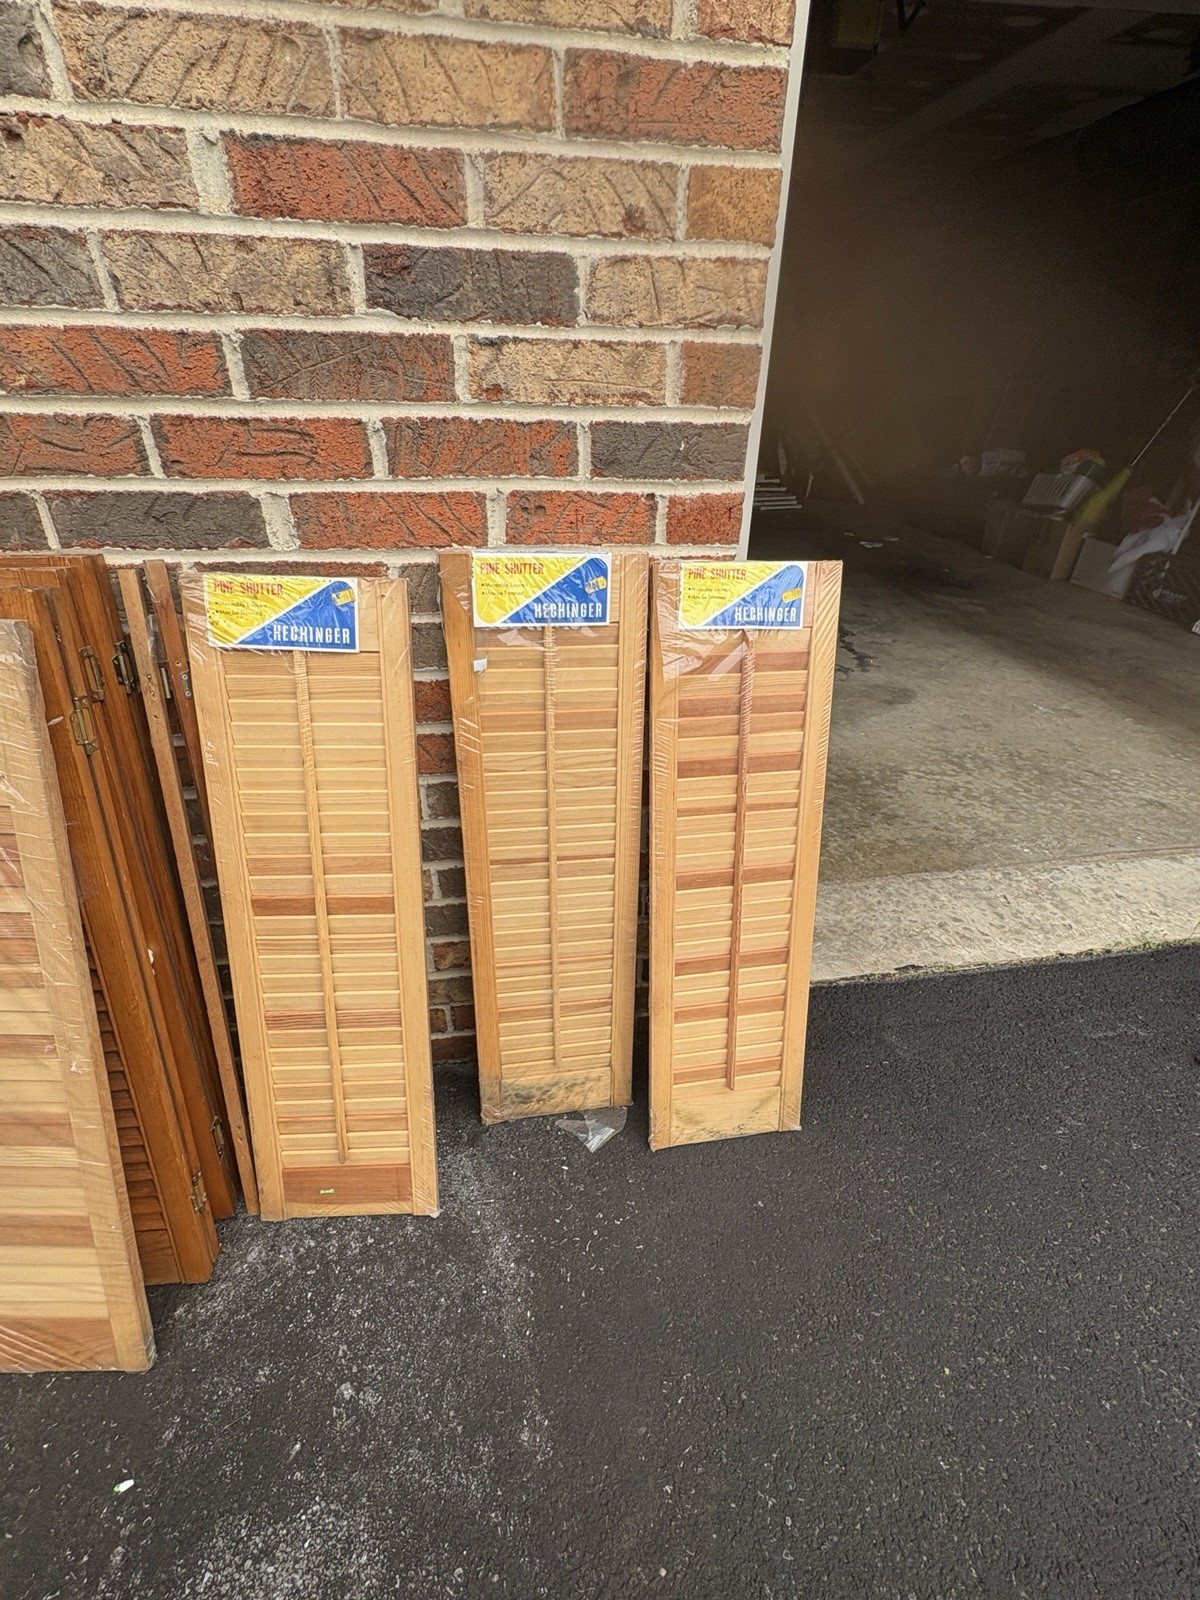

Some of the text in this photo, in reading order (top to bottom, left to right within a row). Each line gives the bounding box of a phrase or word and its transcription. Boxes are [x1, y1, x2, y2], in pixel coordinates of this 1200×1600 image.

[480, 562, 544, 575] PINE SHUTTER
[688, 568, 747, 580] PINE SHUTTER
[213, 580, 284, 596] PINE SHUTTER
[534, 602, 603, 618] HECHINGER
[734, 606, 797, 622] HECHINGER
[273, 625, 350, 644] HECHINGER
